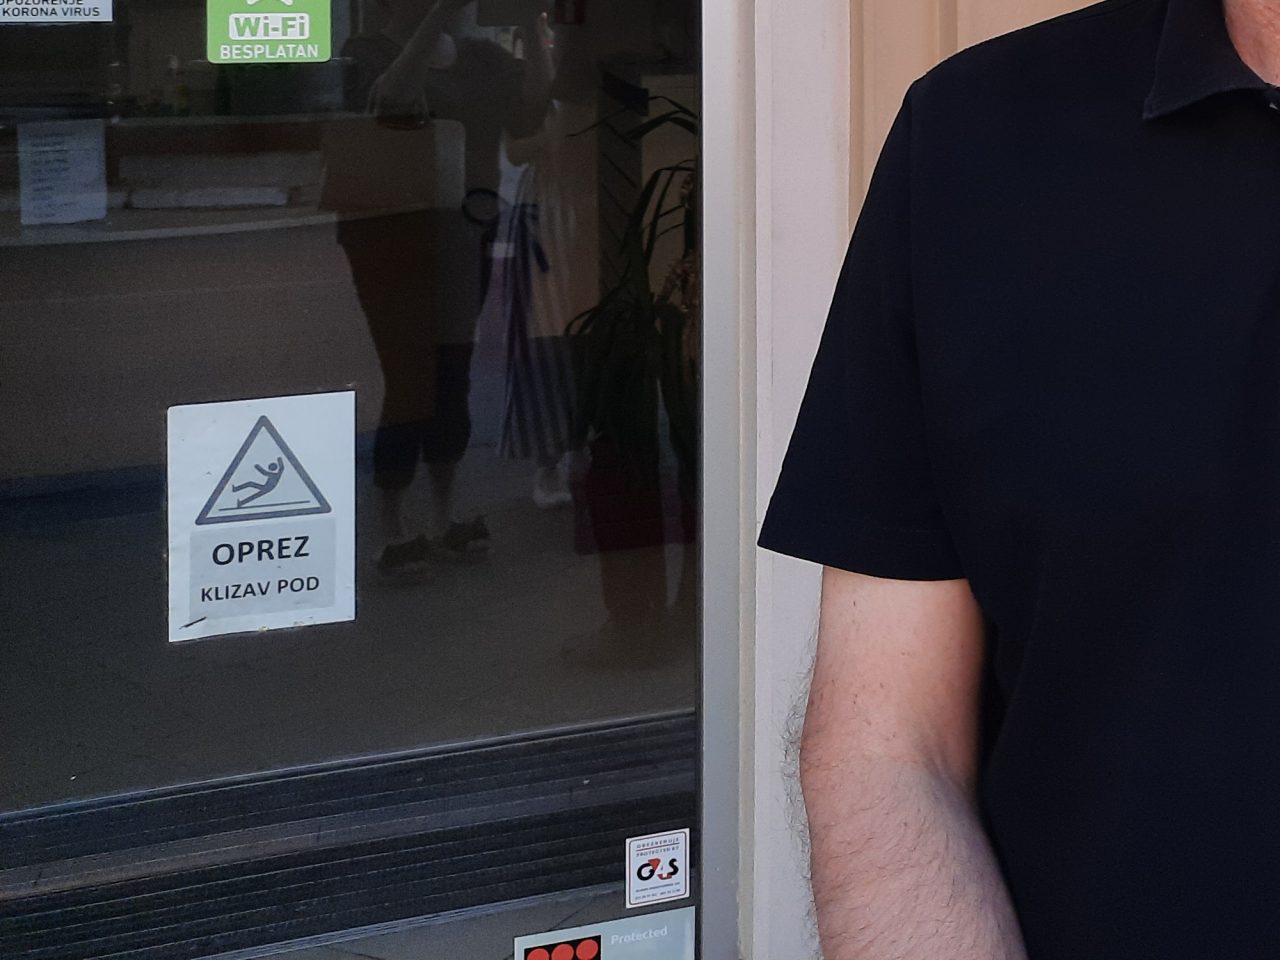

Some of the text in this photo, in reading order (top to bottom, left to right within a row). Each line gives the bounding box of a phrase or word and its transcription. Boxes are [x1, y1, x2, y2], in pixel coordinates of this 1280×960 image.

[2, 6, 100, 17] KORONA VIRUS
[233, 16, 306, 37] Wi-Fi
[220, 44, 318, 59] BESPLATAN
[212, 535, 310, 566] OPREZ
[201, 576, 320, 602] KLIZAV POD
[636, 858, 679, 881] G4S
[611, 925, 668, 945] Protected
